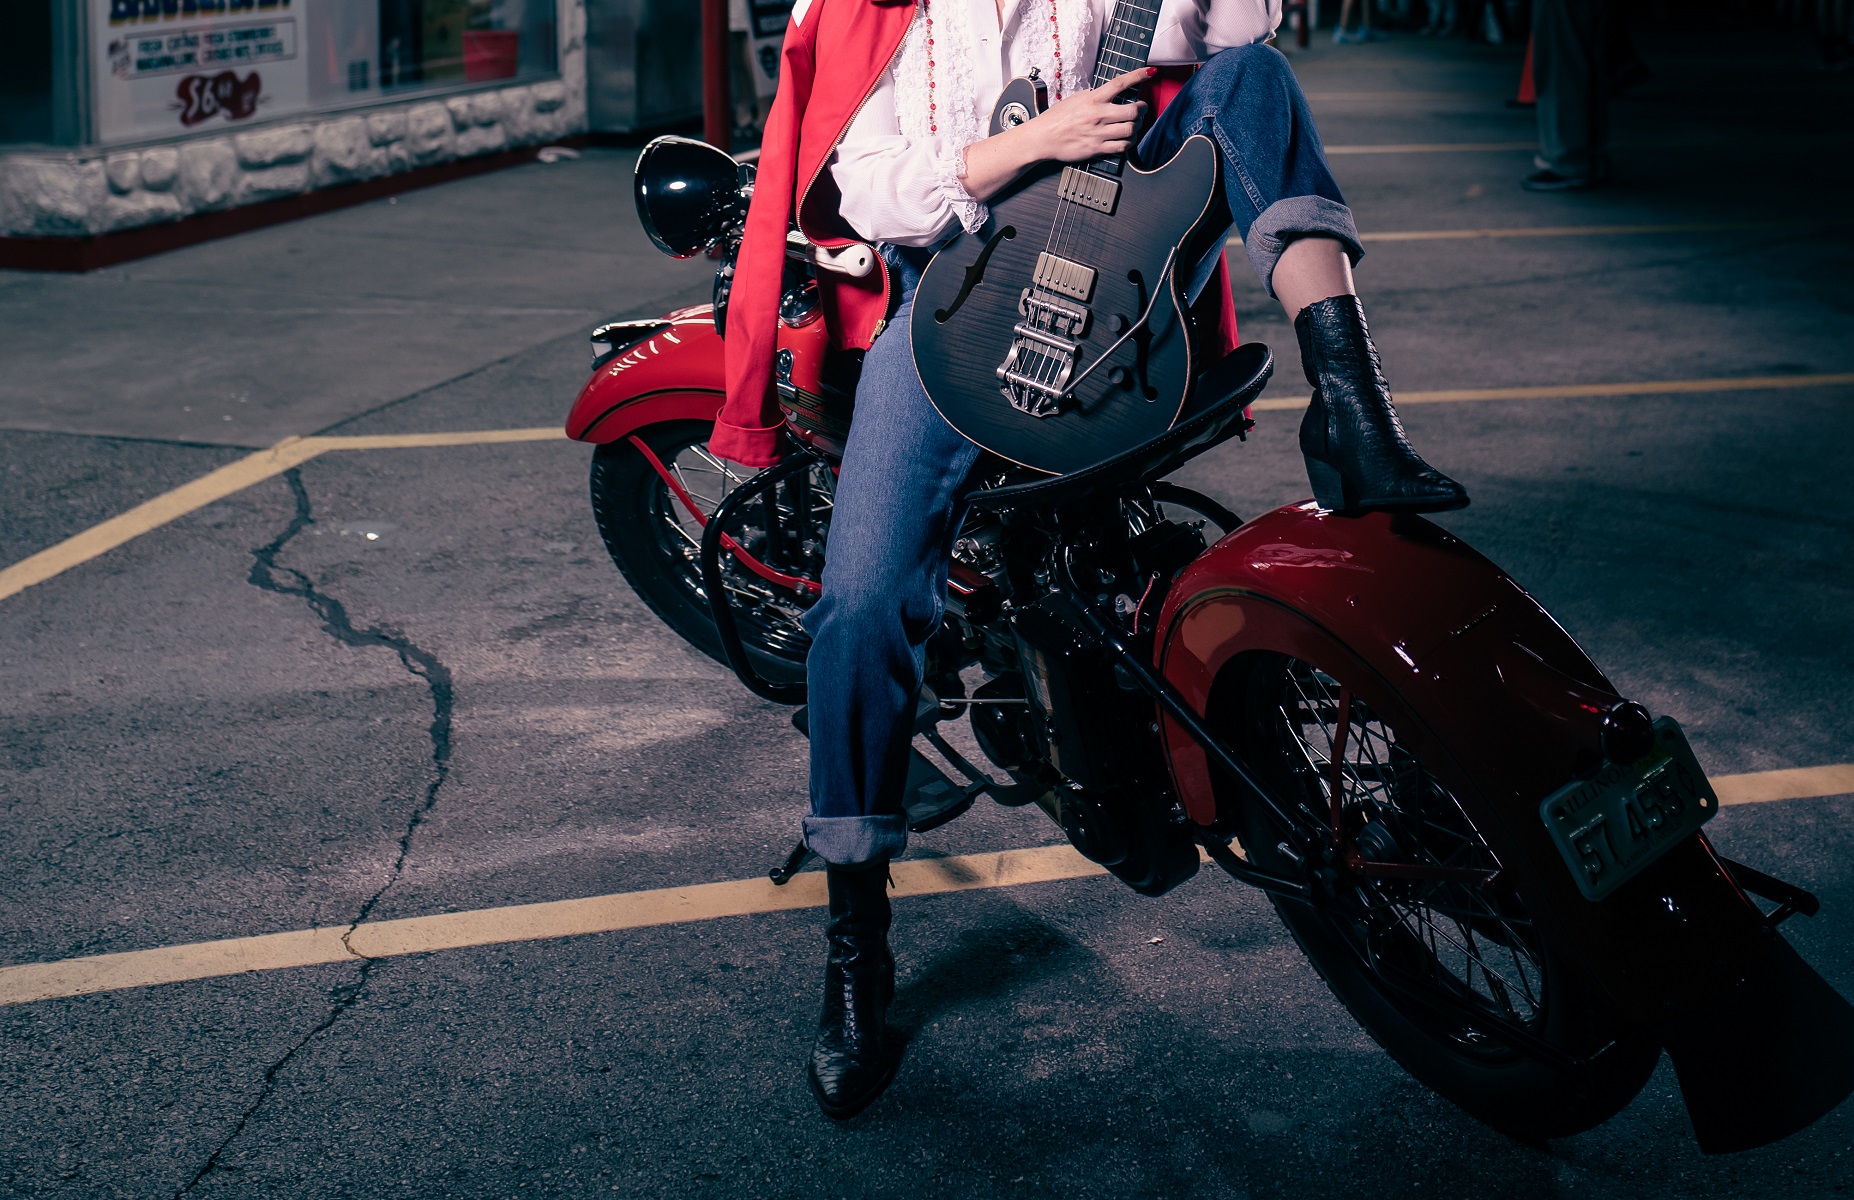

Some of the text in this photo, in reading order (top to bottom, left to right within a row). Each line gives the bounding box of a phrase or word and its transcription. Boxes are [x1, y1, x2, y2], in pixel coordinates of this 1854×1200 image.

[1565, 762, 1635, 814] ILLINOIS
[1569, 770, 1686, 877] 57 455
